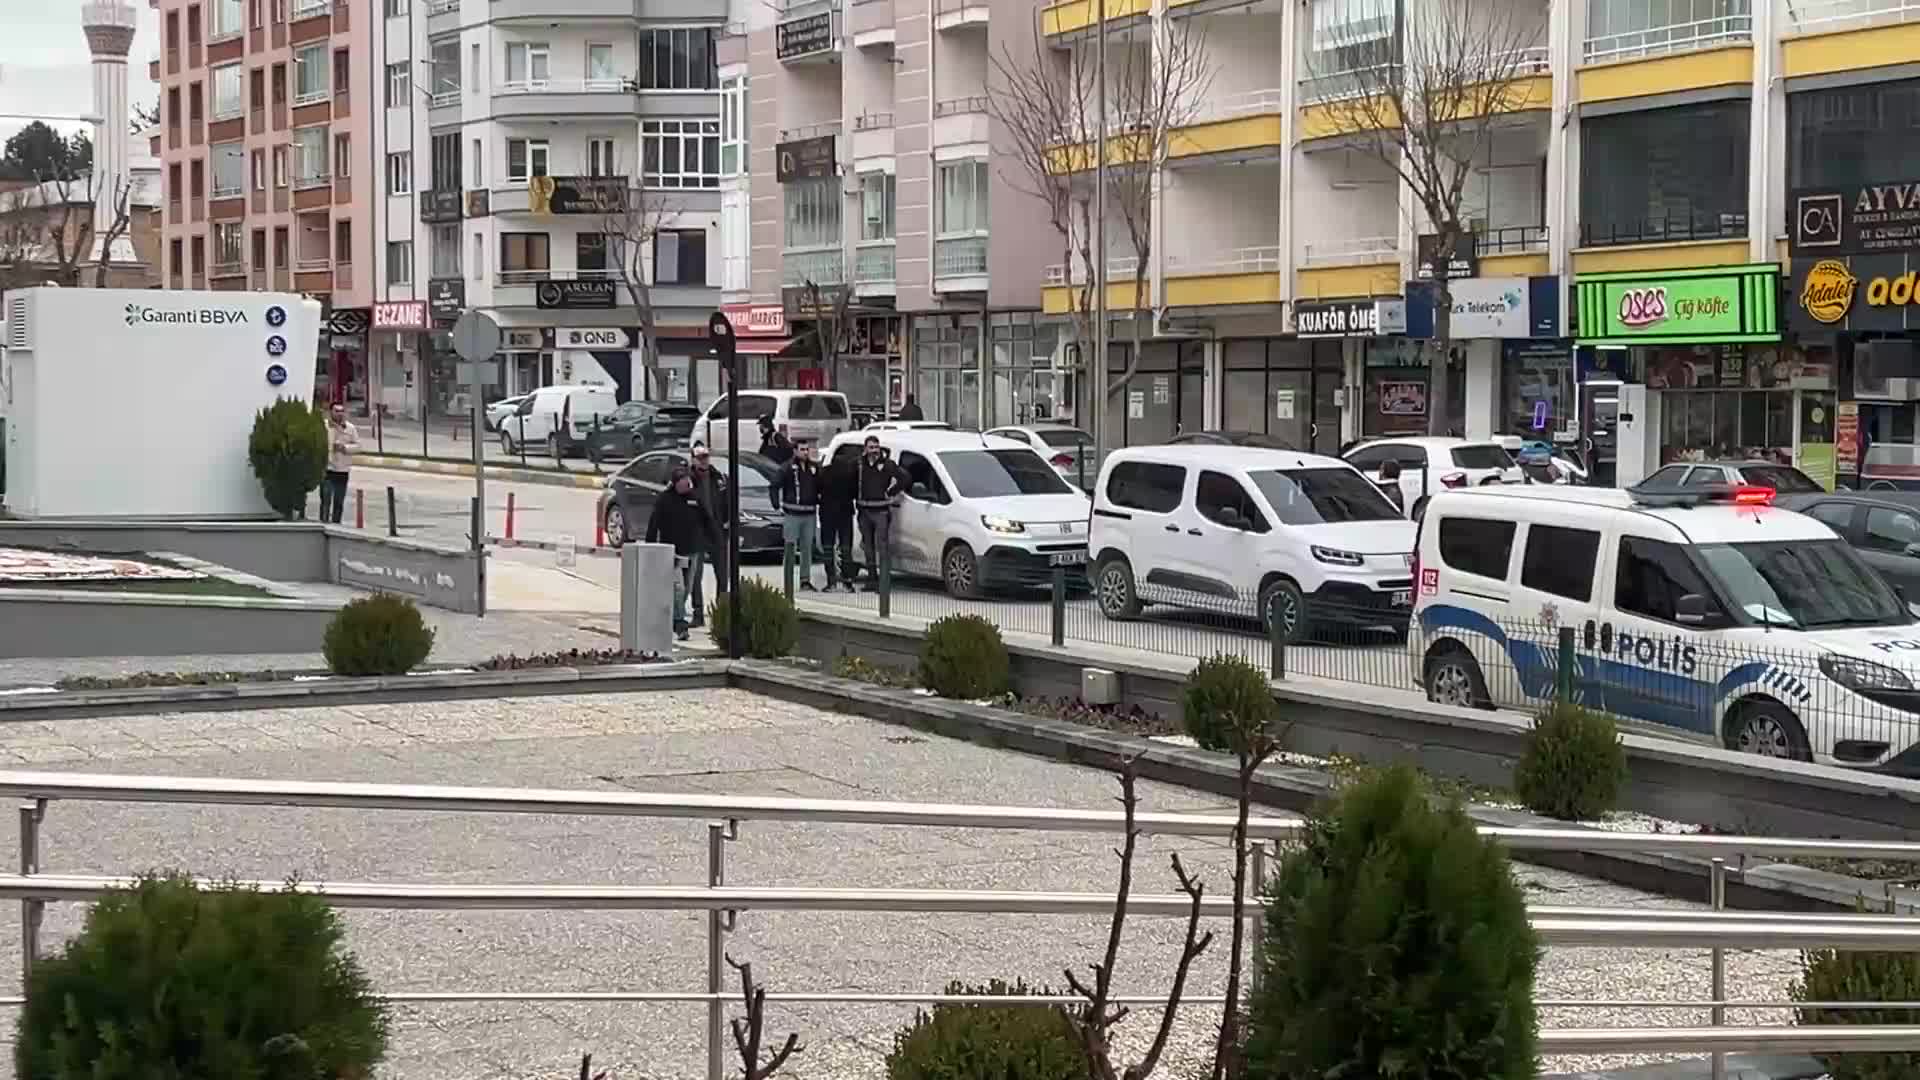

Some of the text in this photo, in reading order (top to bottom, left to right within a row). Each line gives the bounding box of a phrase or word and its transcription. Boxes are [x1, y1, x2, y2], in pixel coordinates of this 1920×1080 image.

[1803, 207, 1836, 235] CA
[564, 282, 613, 293] ARSLAN
[1804, 278, 1859, 304] Adalet
[142, 307, 248, 324] Garanti BBVA
[374, 304, 422, 326] ECZANE
[1467, 301, 1505, 313] Telekom
[1697, 296, 1729, 318] köfte
[1298, 305, 1345, 332] KUAFÖR
[584, 331, 617, 344] QNB
[1424, 571, 1437, 585] 112
[1617, 632, 1697, 675] POLİS
